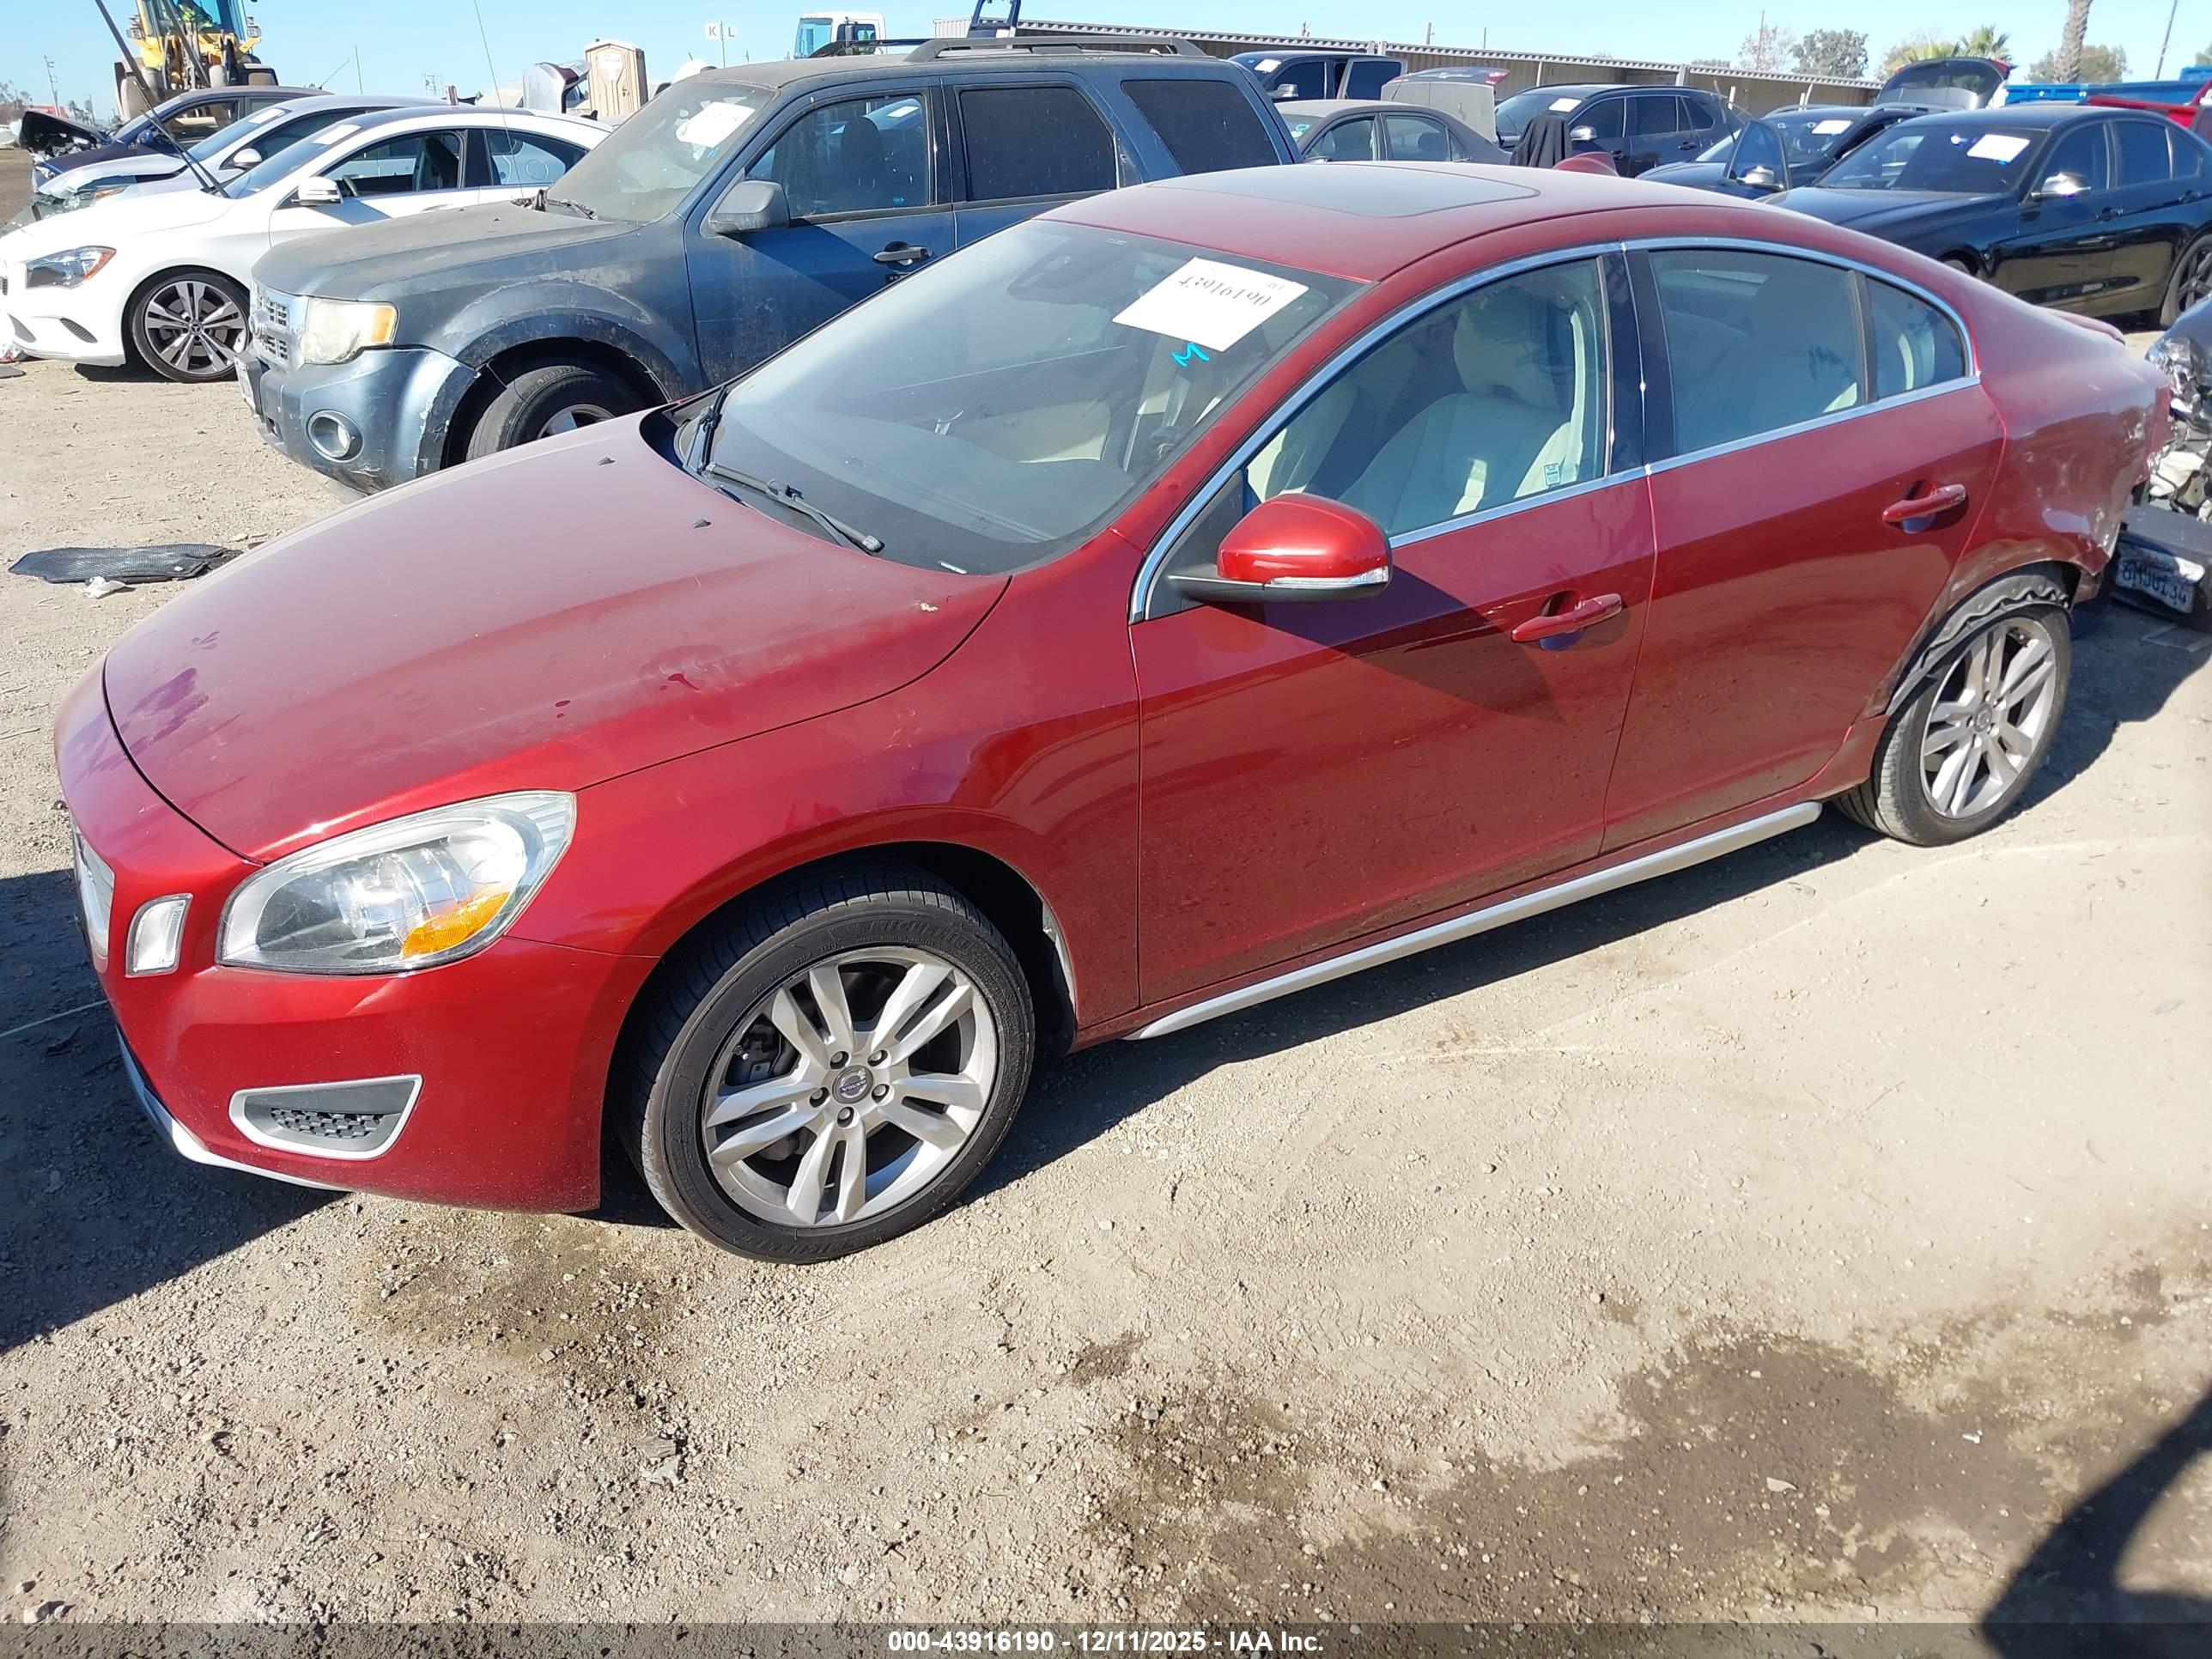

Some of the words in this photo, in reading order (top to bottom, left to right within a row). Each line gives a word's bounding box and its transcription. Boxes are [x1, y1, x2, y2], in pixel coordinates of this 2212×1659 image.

[708, 26, 717, 36] K
[728, 27, 735, 37] L
[1178, 276, 1271, 306] 43916190
[841, 1079, 866, 1091] VOLVO
